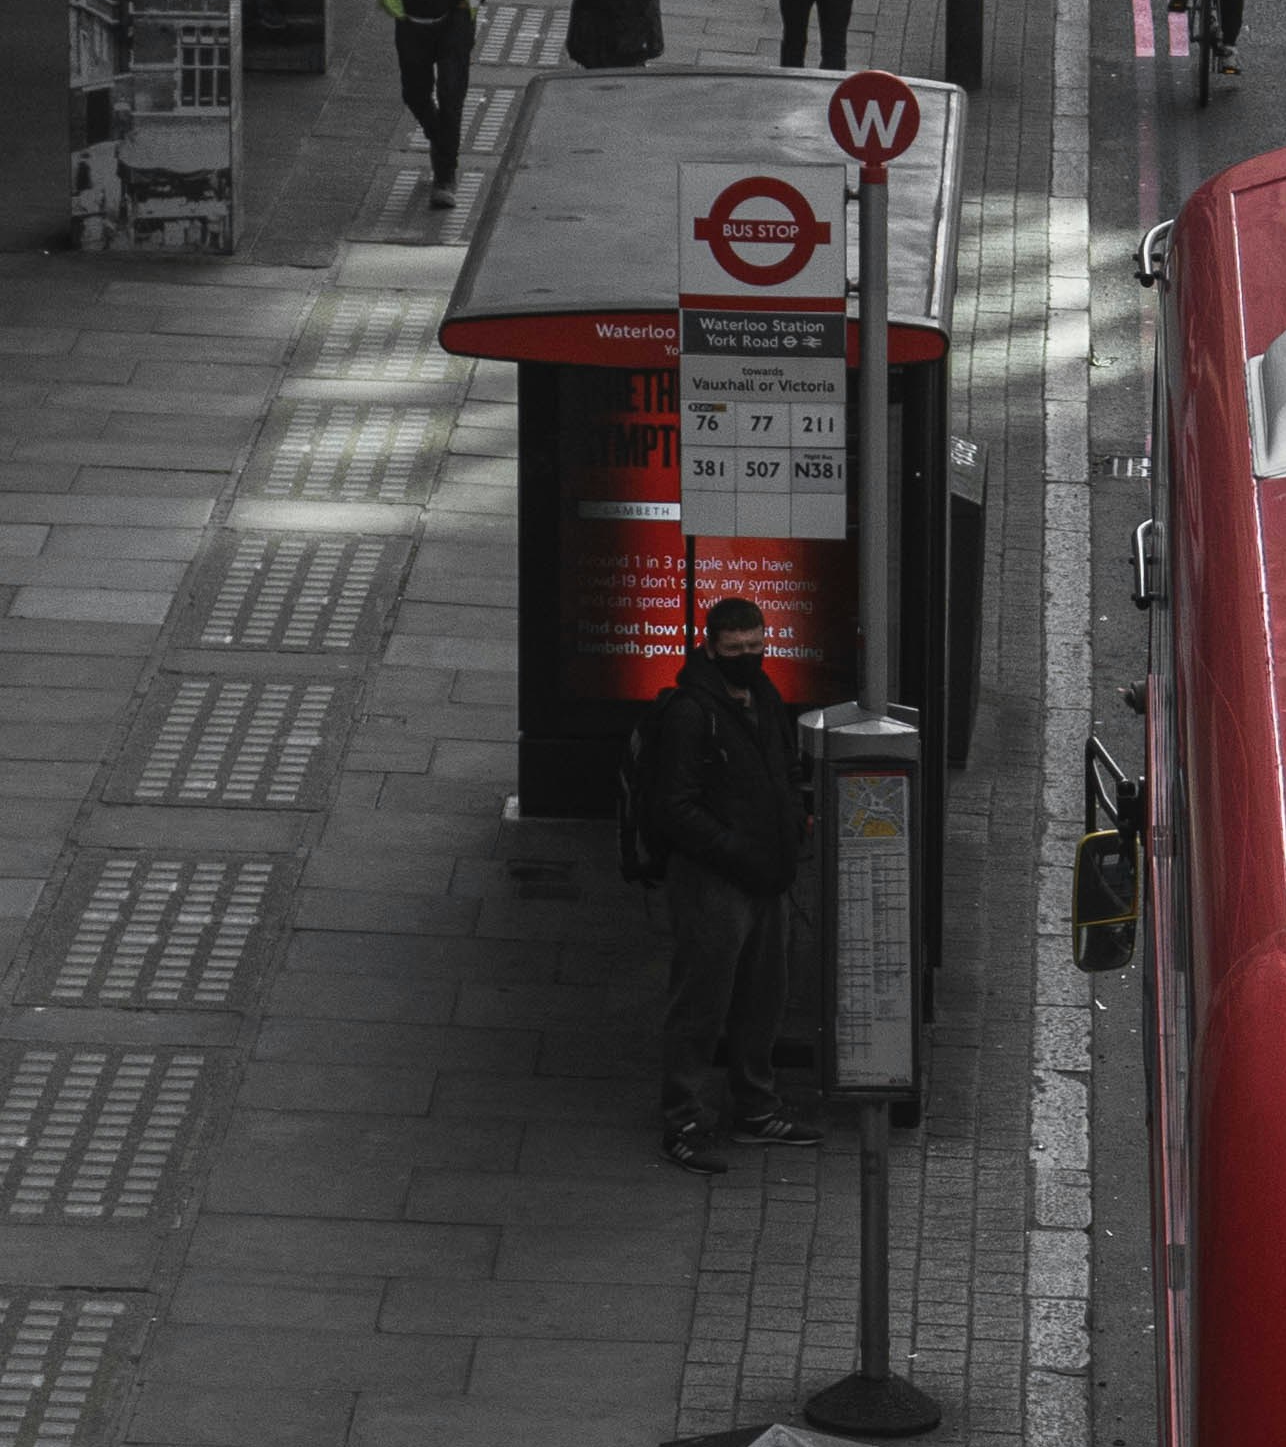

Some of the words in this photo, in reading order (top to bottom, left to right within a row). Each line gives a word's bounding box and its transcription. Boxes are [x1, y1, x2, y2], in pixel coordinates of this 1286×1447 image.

[839, 98, 907, 149] W
[722, 223, 753, 238] BUS
[758, 224, 800, 239] STOP
[595, 323, 676, 340] Waterloo
[699, 317, 767, 333] Waterloo
[772, 319, 825, 334] Station
[706, 334, 736, 347] York
[742, 335, 778, 348] Road
[664, 344, 680, 356] Yo
[741, 367, 784, 377] towards
[692, 376, 755, 392] Vauxhall
[759, 382, 774, 393] or
[778, 379, 835, 394] Victoria
[696, 415, 719, 431] 76
[750, 415, 773, 432] 77
[802, 416, 834, 433] 211
[693, 460, 725, 477] 381
[745, 461, 780, 478] 507
[794, 462, 843, 479] N381
[645, 555, 660, 569] in
[663, 555, 671, 569] 3
[676, 557, 723, 573] pople
[726, 557, 758, 571] who
[762, 557, 794, 572] have
[640, 574, 677, 589] don't
[680, 577, 716, 591] sow
[720, 579, 746, 594] any
[748, 578, 818, 594] symptoms
[635, 594, 681, 612] spread
[613, 623, 641, 636] out
[643, 622, 678, 637] how
[778, 626, 795, 639] at
